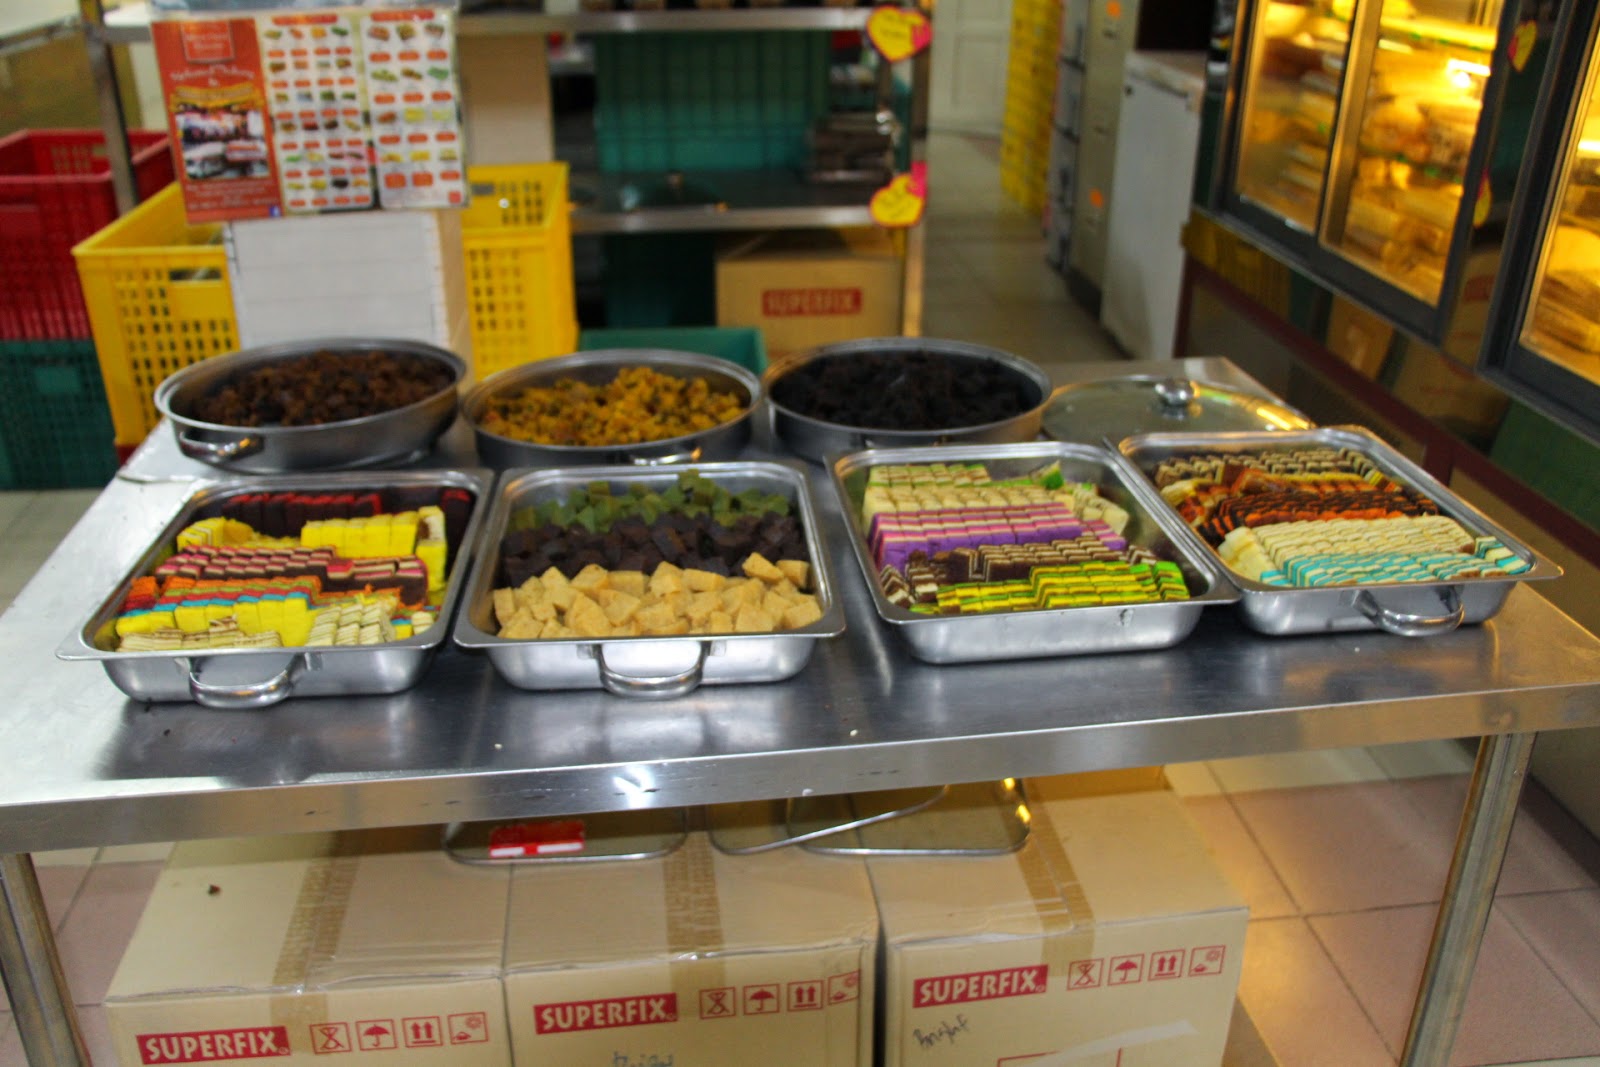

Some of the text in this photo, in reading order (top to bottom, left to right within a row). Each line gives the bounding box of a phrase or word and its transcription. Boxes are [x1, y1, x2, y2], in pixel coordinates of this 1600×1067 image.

[920, 969, 1037, 1004] SUPERFIX
[541, 998, 668, 1031] SUPERFIX
[146, 1030, 278, 1060] SUPERFIX
